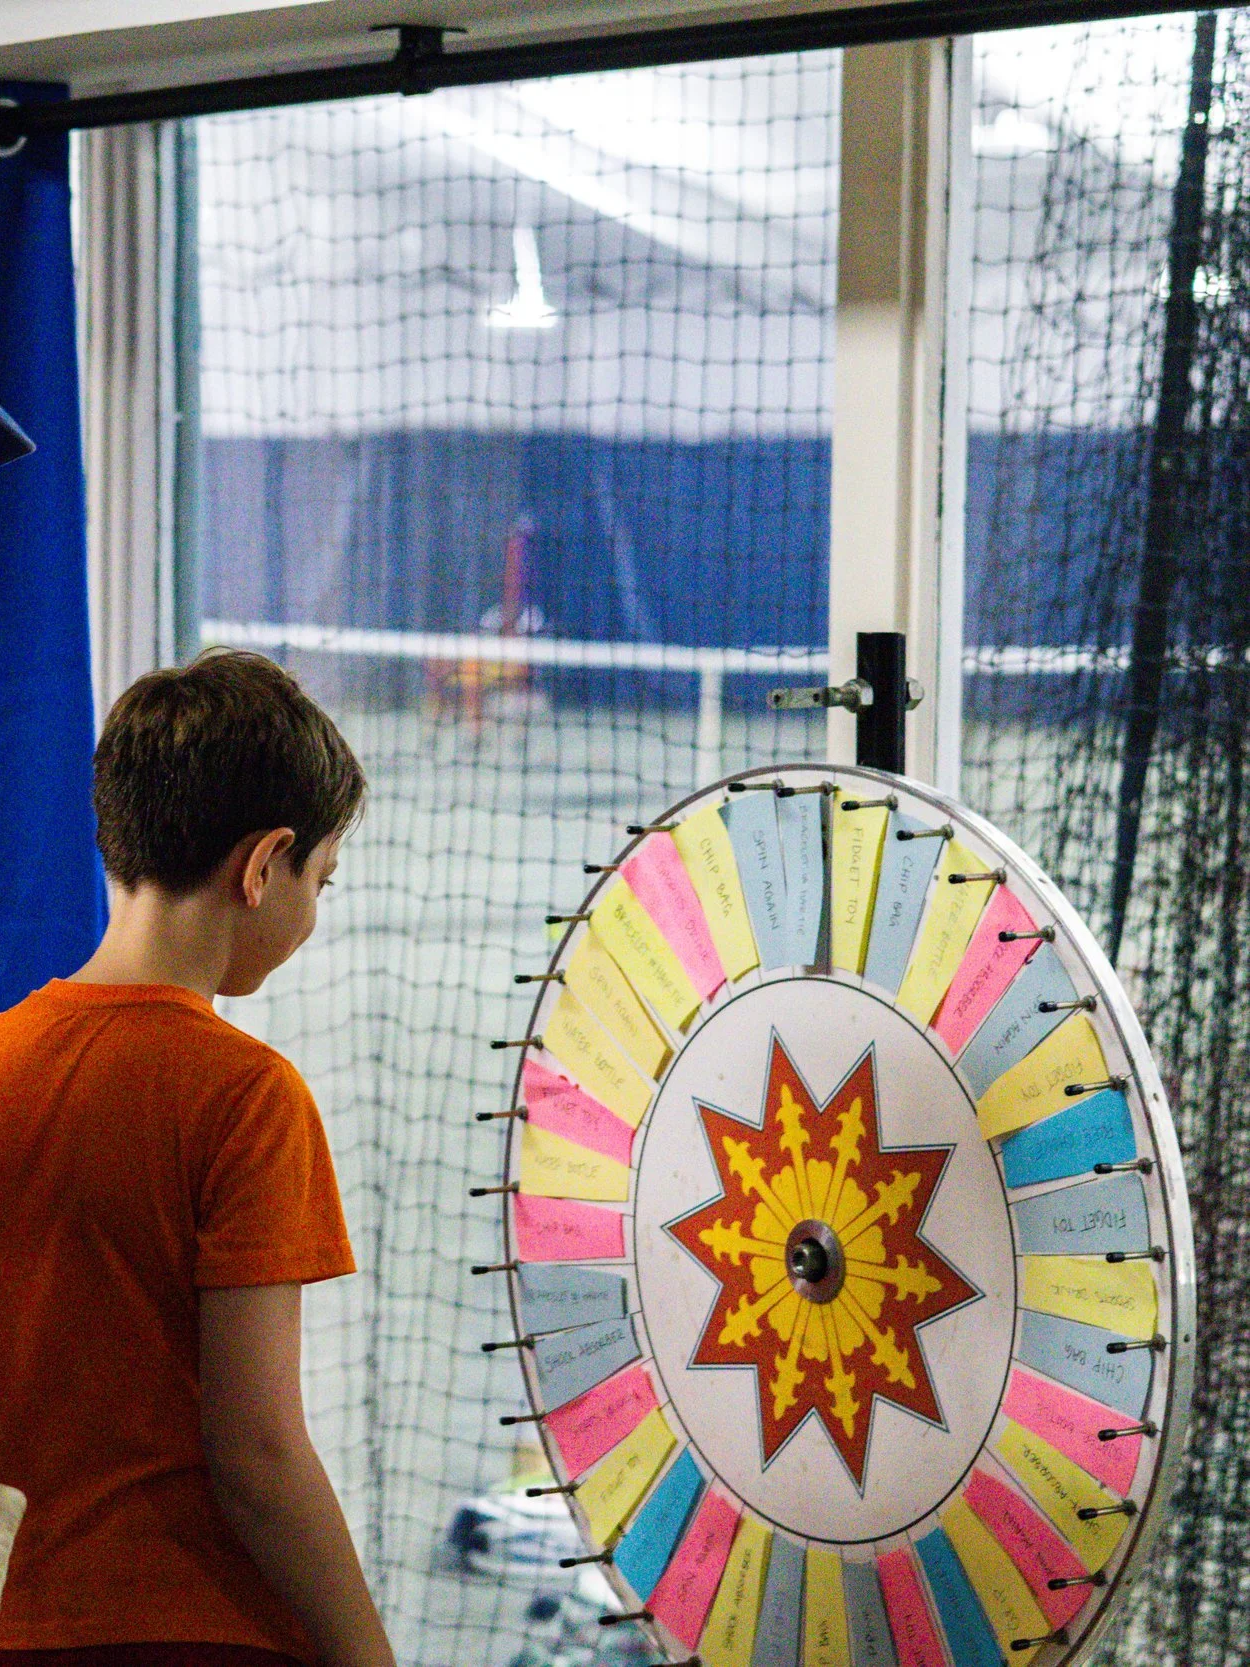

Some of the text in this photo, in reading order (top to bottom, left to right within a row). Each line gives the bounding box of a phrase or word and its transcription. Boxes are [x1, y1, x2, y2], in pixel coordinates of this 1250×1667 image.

[699, 838, 735, 916] CHIP BAG
[751, 829, 782, 930] SPIN AGAIN
[843, 827, 864, 924] FIDGET TOY
[887, 855, 914, 928] CHIP BAG
[954, 961, 993, 1018] ABSORBER
[992, 1022, 1020, 1053] AGAIN
[1044, 1059, 1082, 1088] FIDGET
[1052, 1209, 1126, 1233] FIDGET TOY
[1061, 1343, 1125, 1382] CHIP BAG
